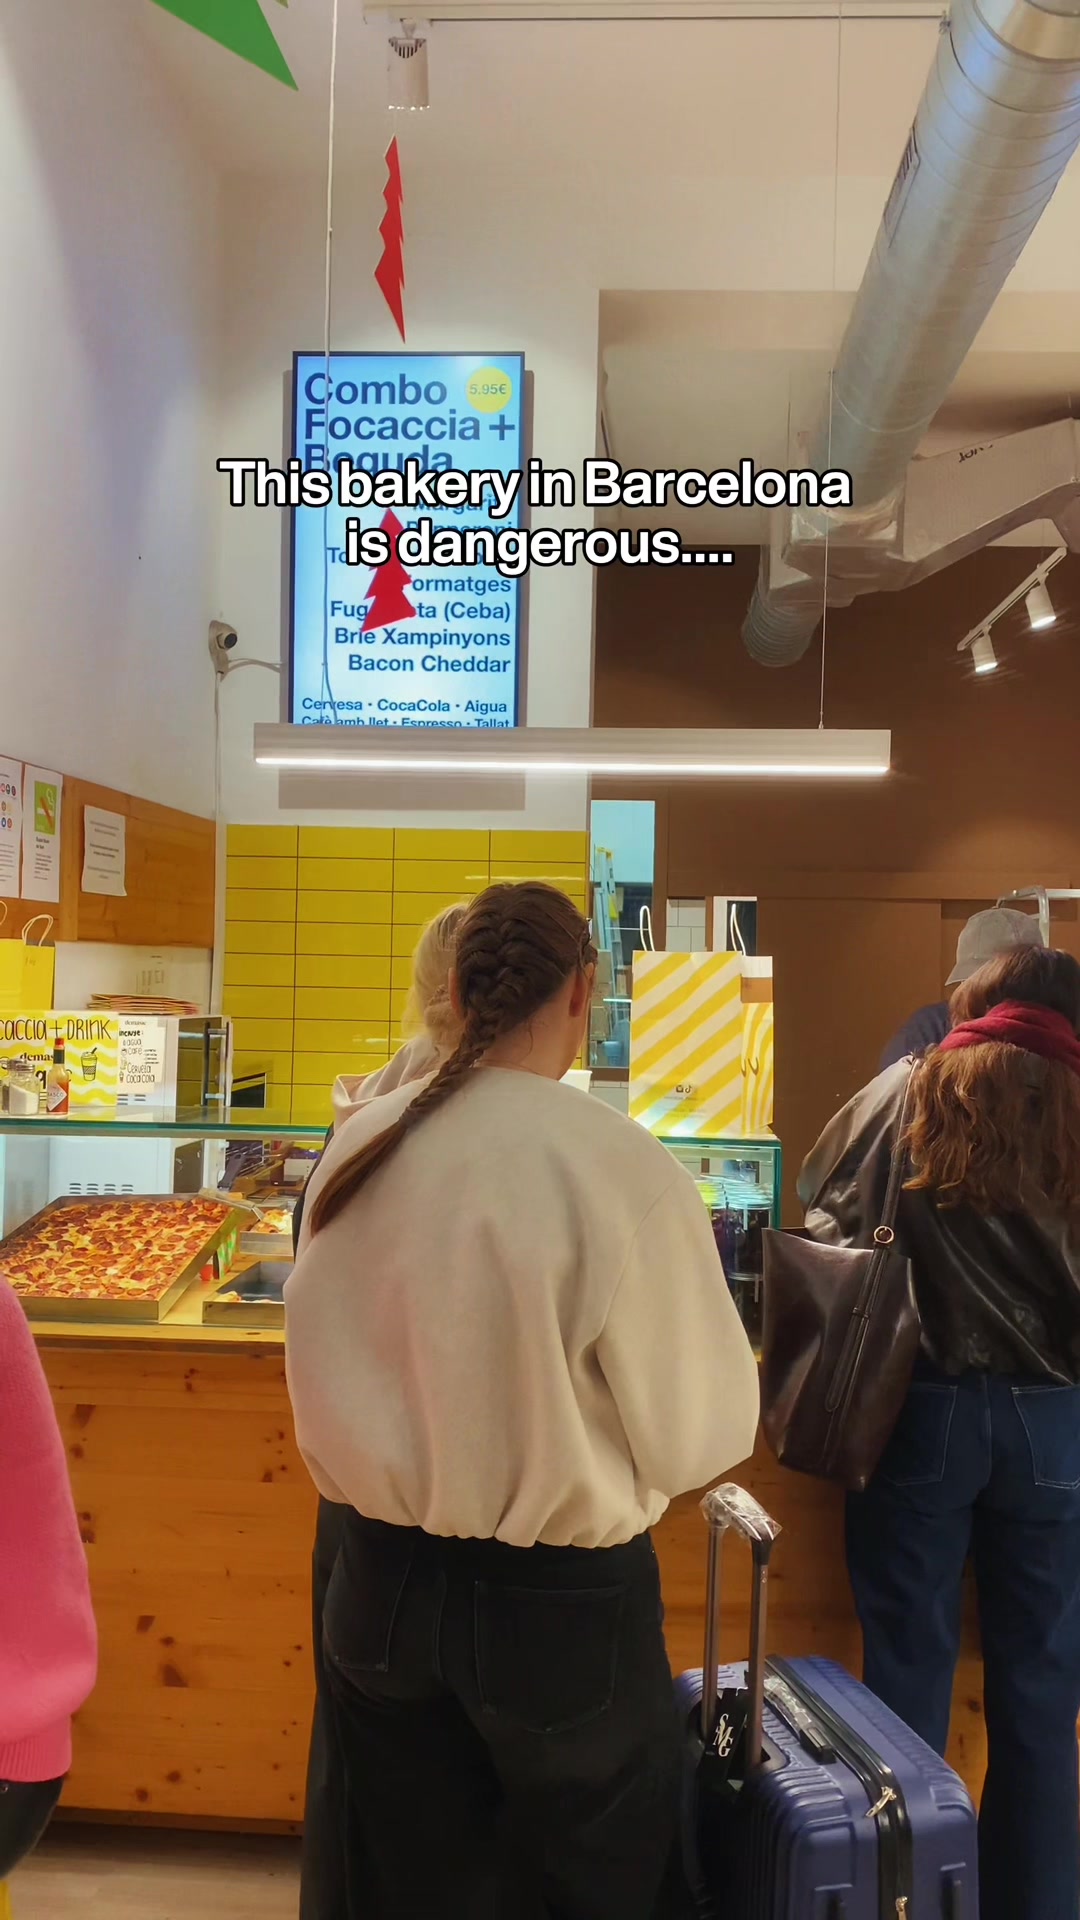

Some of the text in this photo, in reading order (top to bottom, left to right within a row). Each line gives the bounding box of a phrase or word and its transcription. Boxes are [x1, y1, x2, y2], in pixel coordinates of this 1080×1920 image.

[304, 372, 448, 405] Combo
[469, 383, 507, 395] 5.95€
[304, 408, 516, 441] Focaccia +
[409, 575, 511, 595] ormatges
[444, 601, 511, 622] (Ceba)
[335, 627, 511, 649] Brie Xampinyons
[348, 654, 511, 672] Bacon Cheddar
[302, 697, 507, 715] Cervesa CocaCola Aigua
